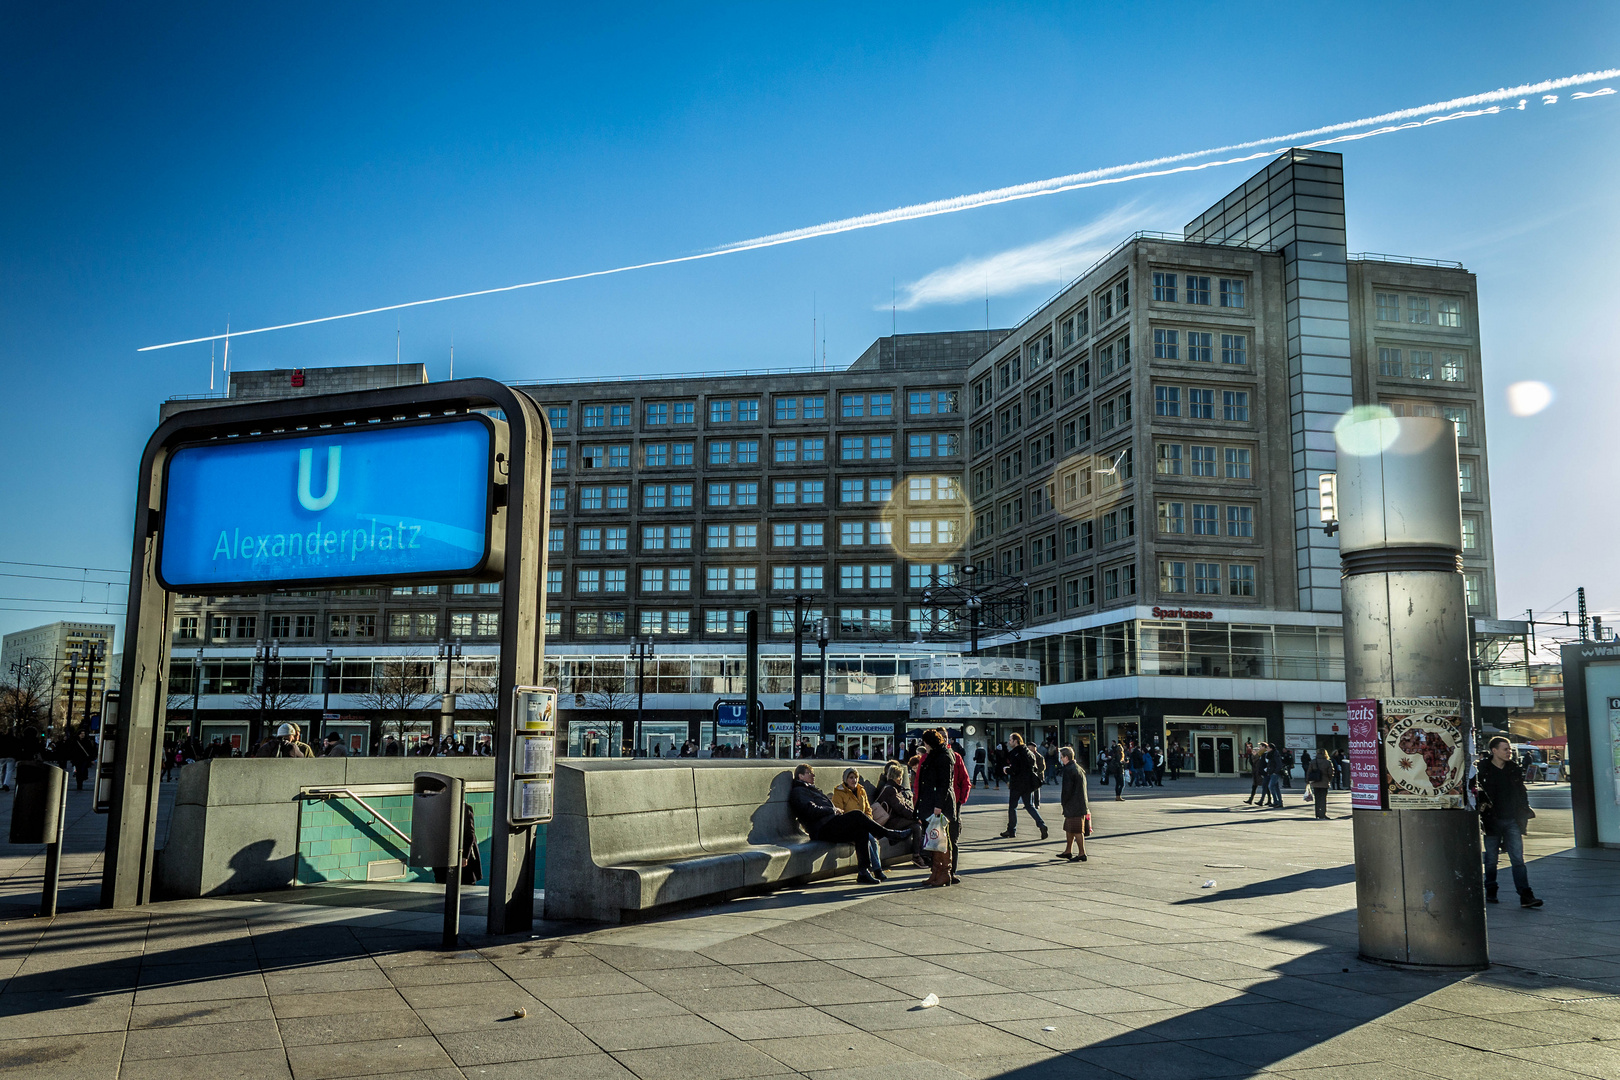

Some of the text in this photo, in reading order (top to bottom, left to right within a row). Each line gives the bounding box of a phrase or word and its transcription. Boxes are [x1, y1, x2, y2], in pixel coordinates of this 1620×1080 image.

[297, 445, 342, 512] U
[213, 518, 422, 562] Alexanderplatz
[1152, 607, 1213, 620] Sparkasse
[929, 683, 939, 692] 23
[940, 682, 954, 692] 24
[959, 683, 965, 692] 1
[975, 682, 983, 692] 2
[992, 683, 999, 692] 3
[1006, 682, 1013, 692] 4
[1020, 684, 1025, 692] 5
[1386, 699, 1459, 708] PASSIONSKIRCHE
[733, 706, 741, 717] U
[720, 718, 746, 726] Alexanderp
[1387, 718, 1413, 748] AFRO
[1424, 715, 1462, 748] GOSPEL
[1399, 779, 1428, 795] BONA
